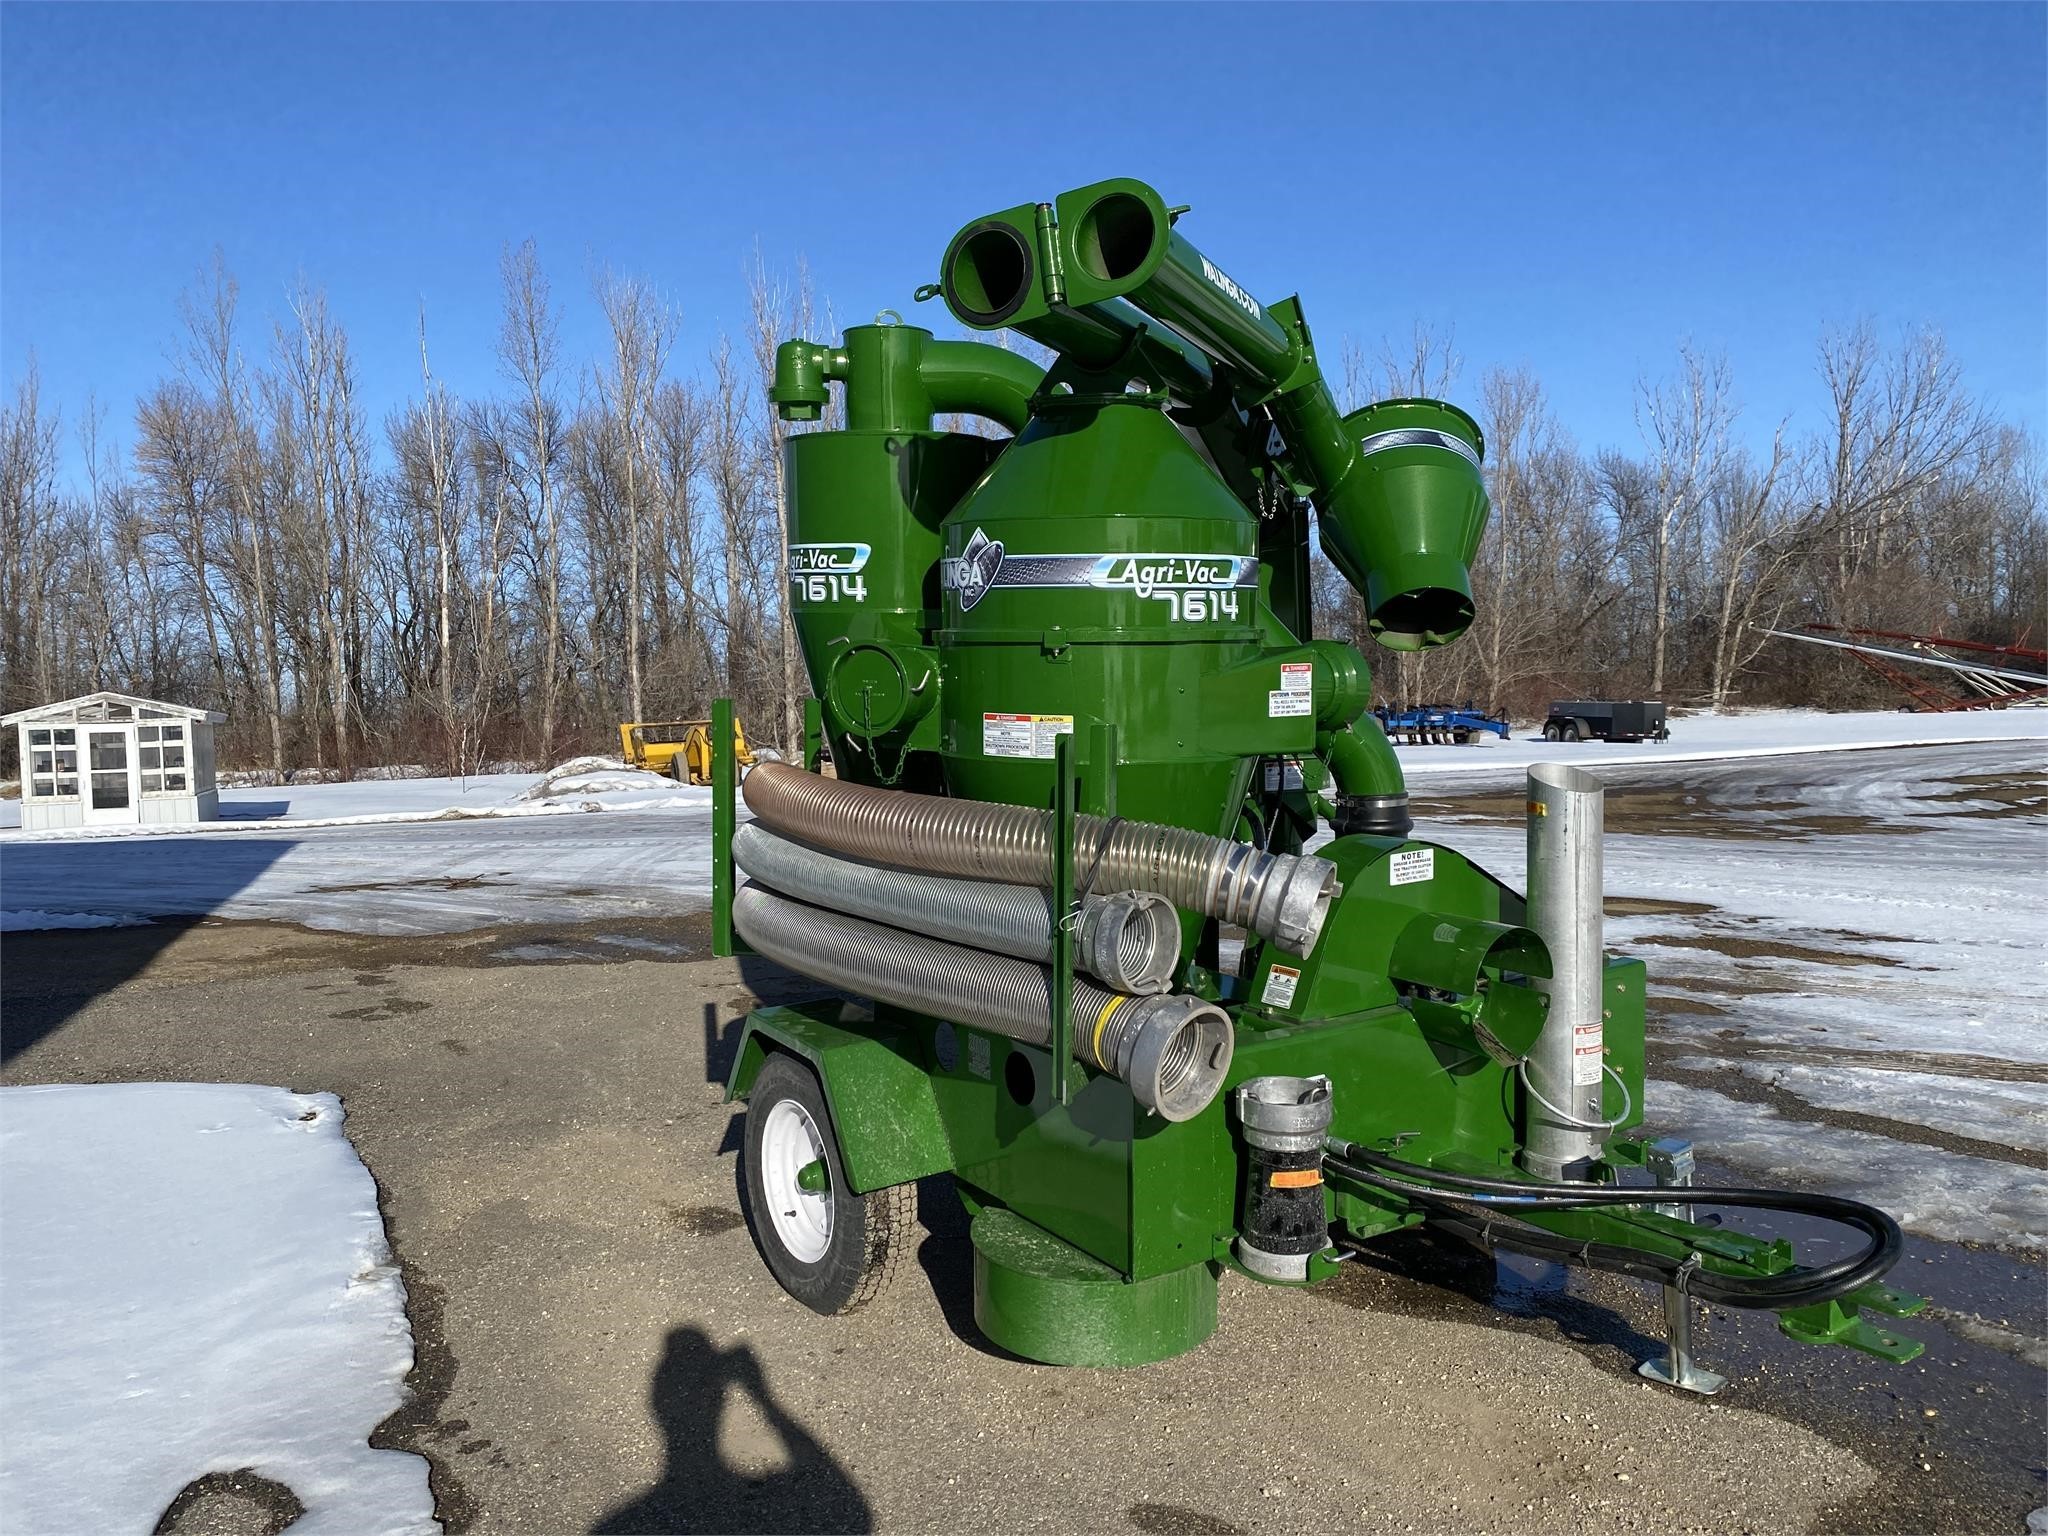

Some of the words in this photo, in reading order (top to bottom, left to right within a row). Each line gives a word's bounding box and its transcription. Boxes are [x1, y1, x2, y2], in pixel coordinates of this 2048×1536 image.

[789, 549, 839, 581] gri-Vac
[1119, 558, 1221, 598] Agri-Vac
[792, 575, 868, 603] 7614
[1152, 590, 1239, 622] 7614
[1401, 851, 1424, 861] NOTE!
